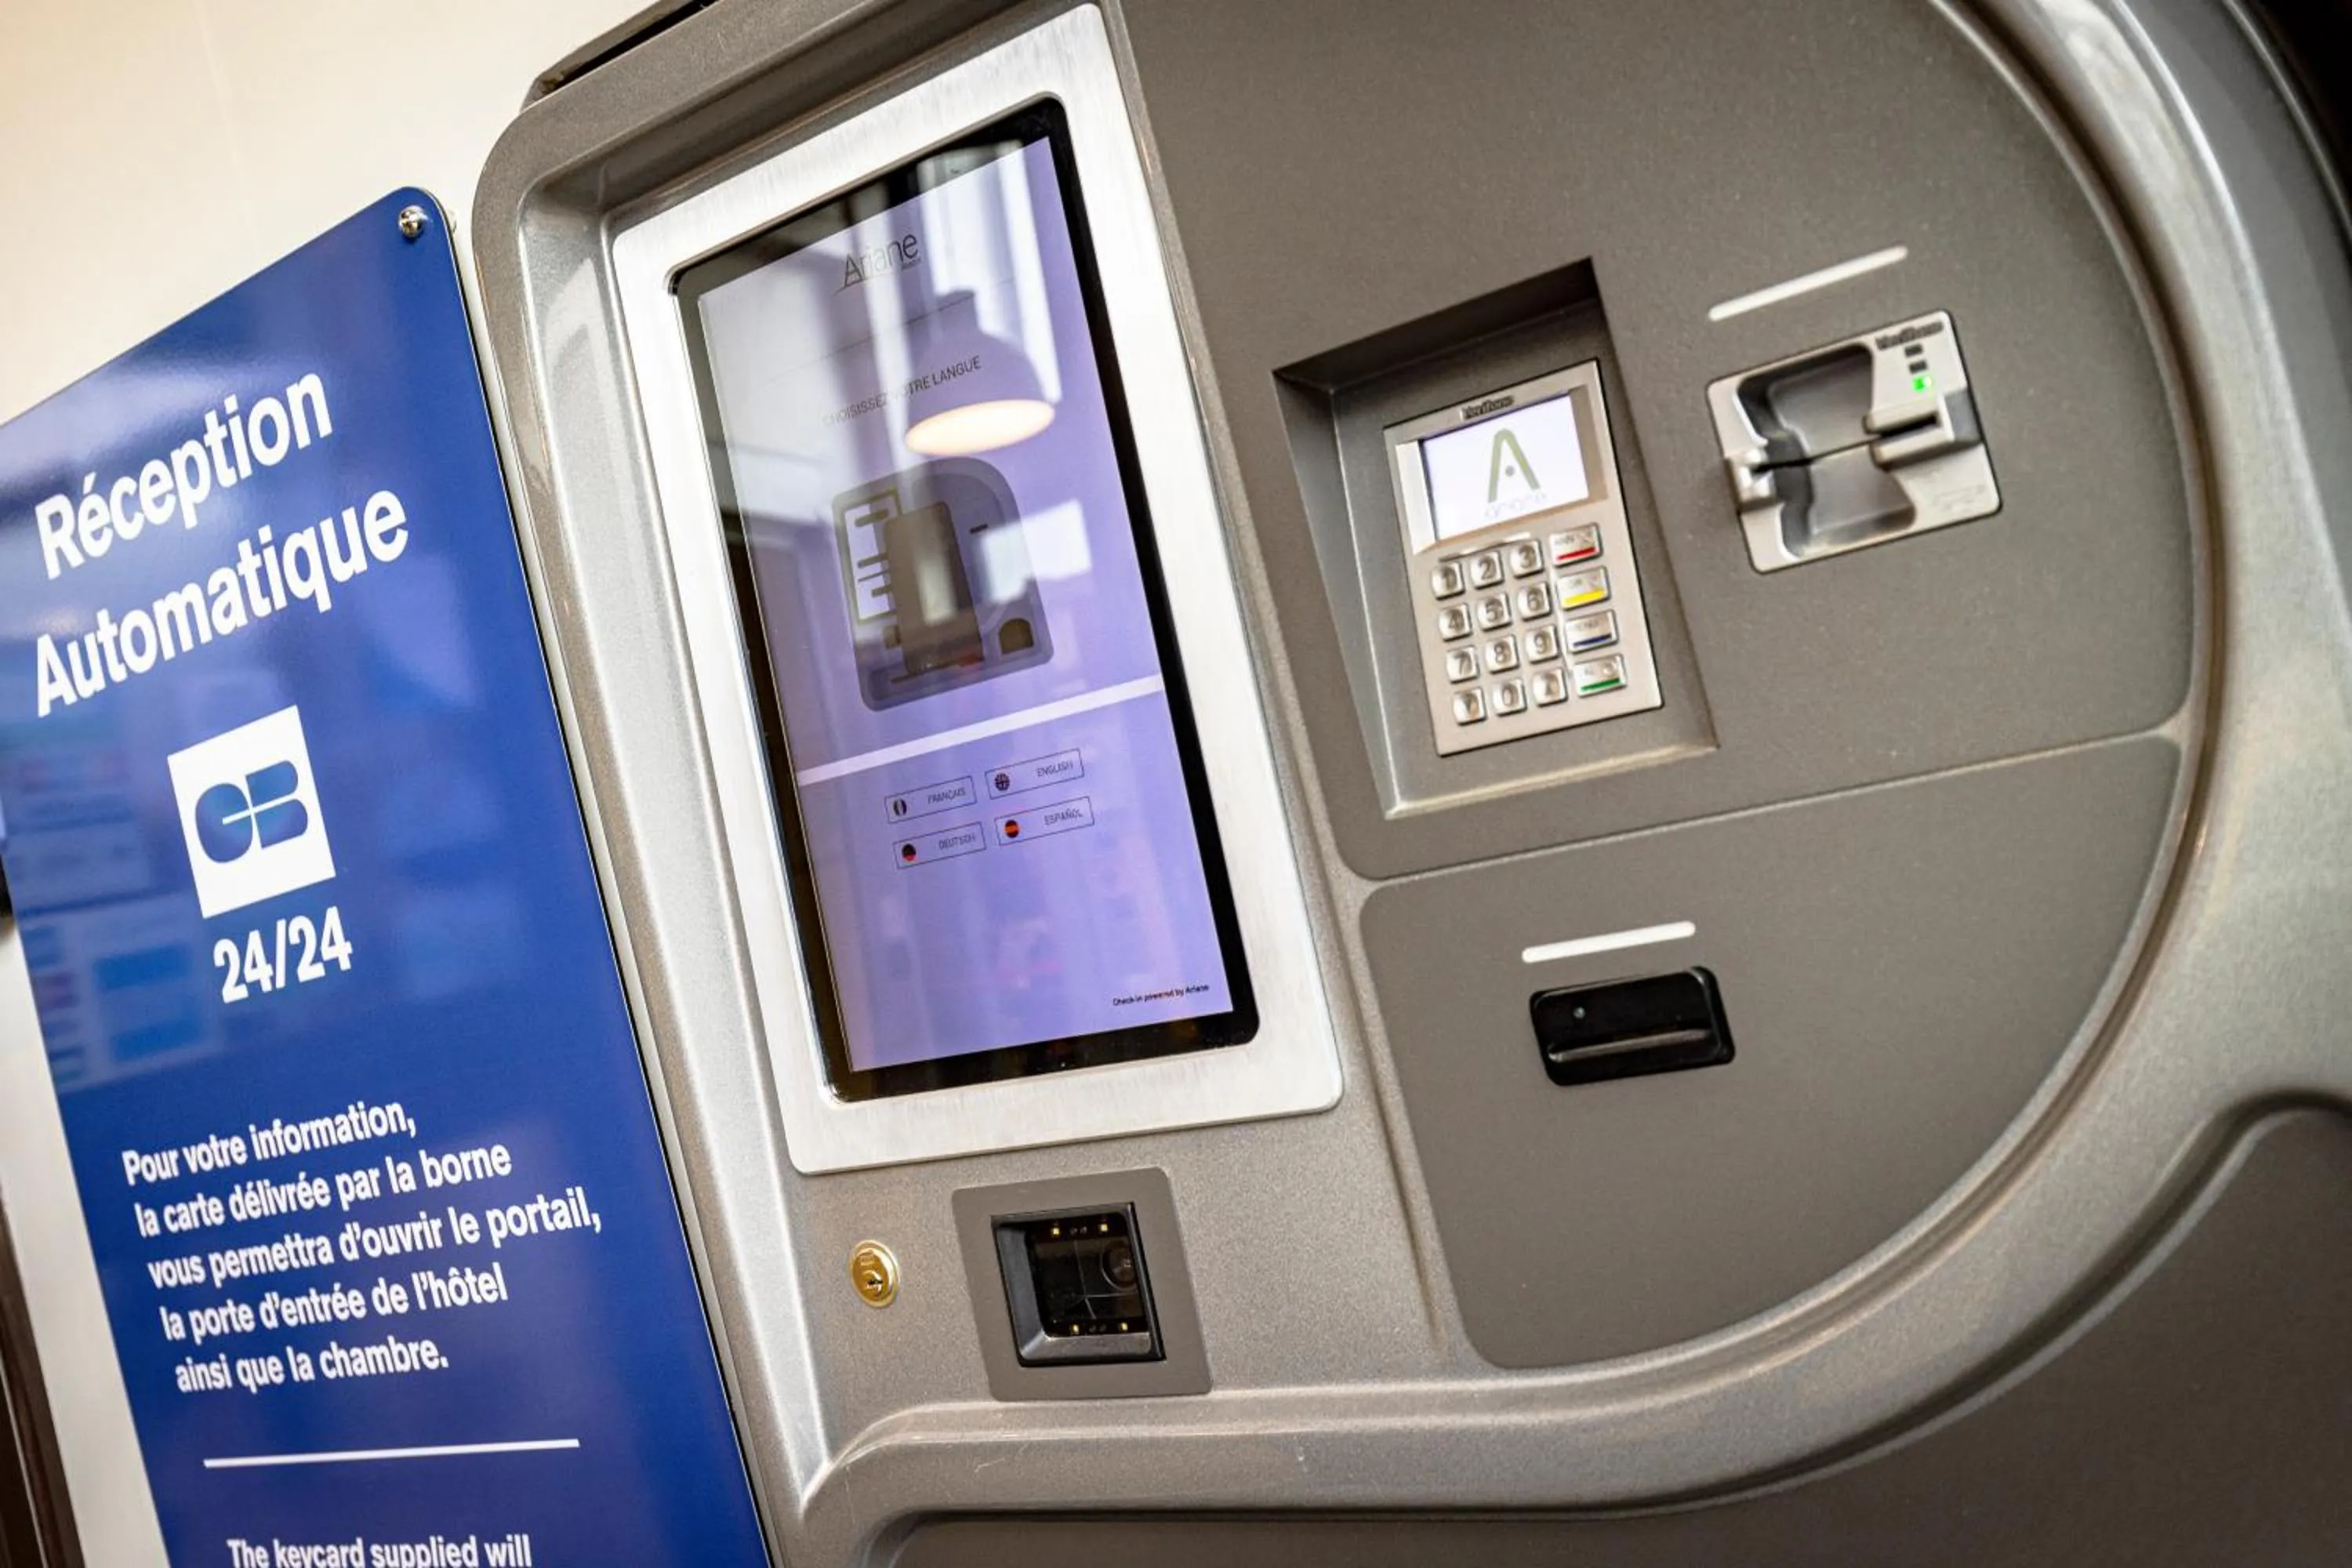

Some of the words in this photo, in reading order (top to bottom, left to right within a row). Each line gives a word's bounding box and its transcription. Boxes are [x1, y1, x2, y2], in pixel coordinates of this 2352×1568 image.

[888, 376, 931, 401] OTRE
[931, 355, 982, 387] LANGUE
[34, 372, 333, 581] Réception
[35, 489, 408, 718] Automatique
[1036, 760, 1073, 778] ENGLISH
[212, 906, 353, 1004] 24/24
[122, 1149, 179, 1185] Pour
[183, 1134, 248, 1173] votre
[249, 1101, 416, 1160] information,
[134, 1202, 160, 1237] la
[163, 1192, 225, 1233] carte
[228, 1171, 332, 1221] délivrée
[335, 1168, 381, 1212] par
[385, 1156, 416, 1194] la
[419, 1142, 513, 1188] borne
[147, 1254, 205, 1288] vous
[208, 1232, 335, 1288] permettra
[339, 1215, 444, 1261] d'ouvrir
[448, 1206, 481, 1245] le
[485, 1186, 601, 1249] portail,
[159, 1305, 186, 1341] la
[189, 1298, 256, 1345] porte
[259, 1280, 367, 1328] d'entrée
[372, 1276, 409, 1316] de
[411, 1261, 509, 1310] l'hôtel
[175, 1359, 233, 1392] ainsi
[236, 1355, 285, 1394] que
[286, 1346, 315, 1382] la
[319, 1335, 448, 1379] chambre.
[227, 1538, 270, 1568] The
[273, 1537, 366, 1568] keycard
[370, 1534, 479, 1568] supplied
[484, 1534, 533, 1567] will
